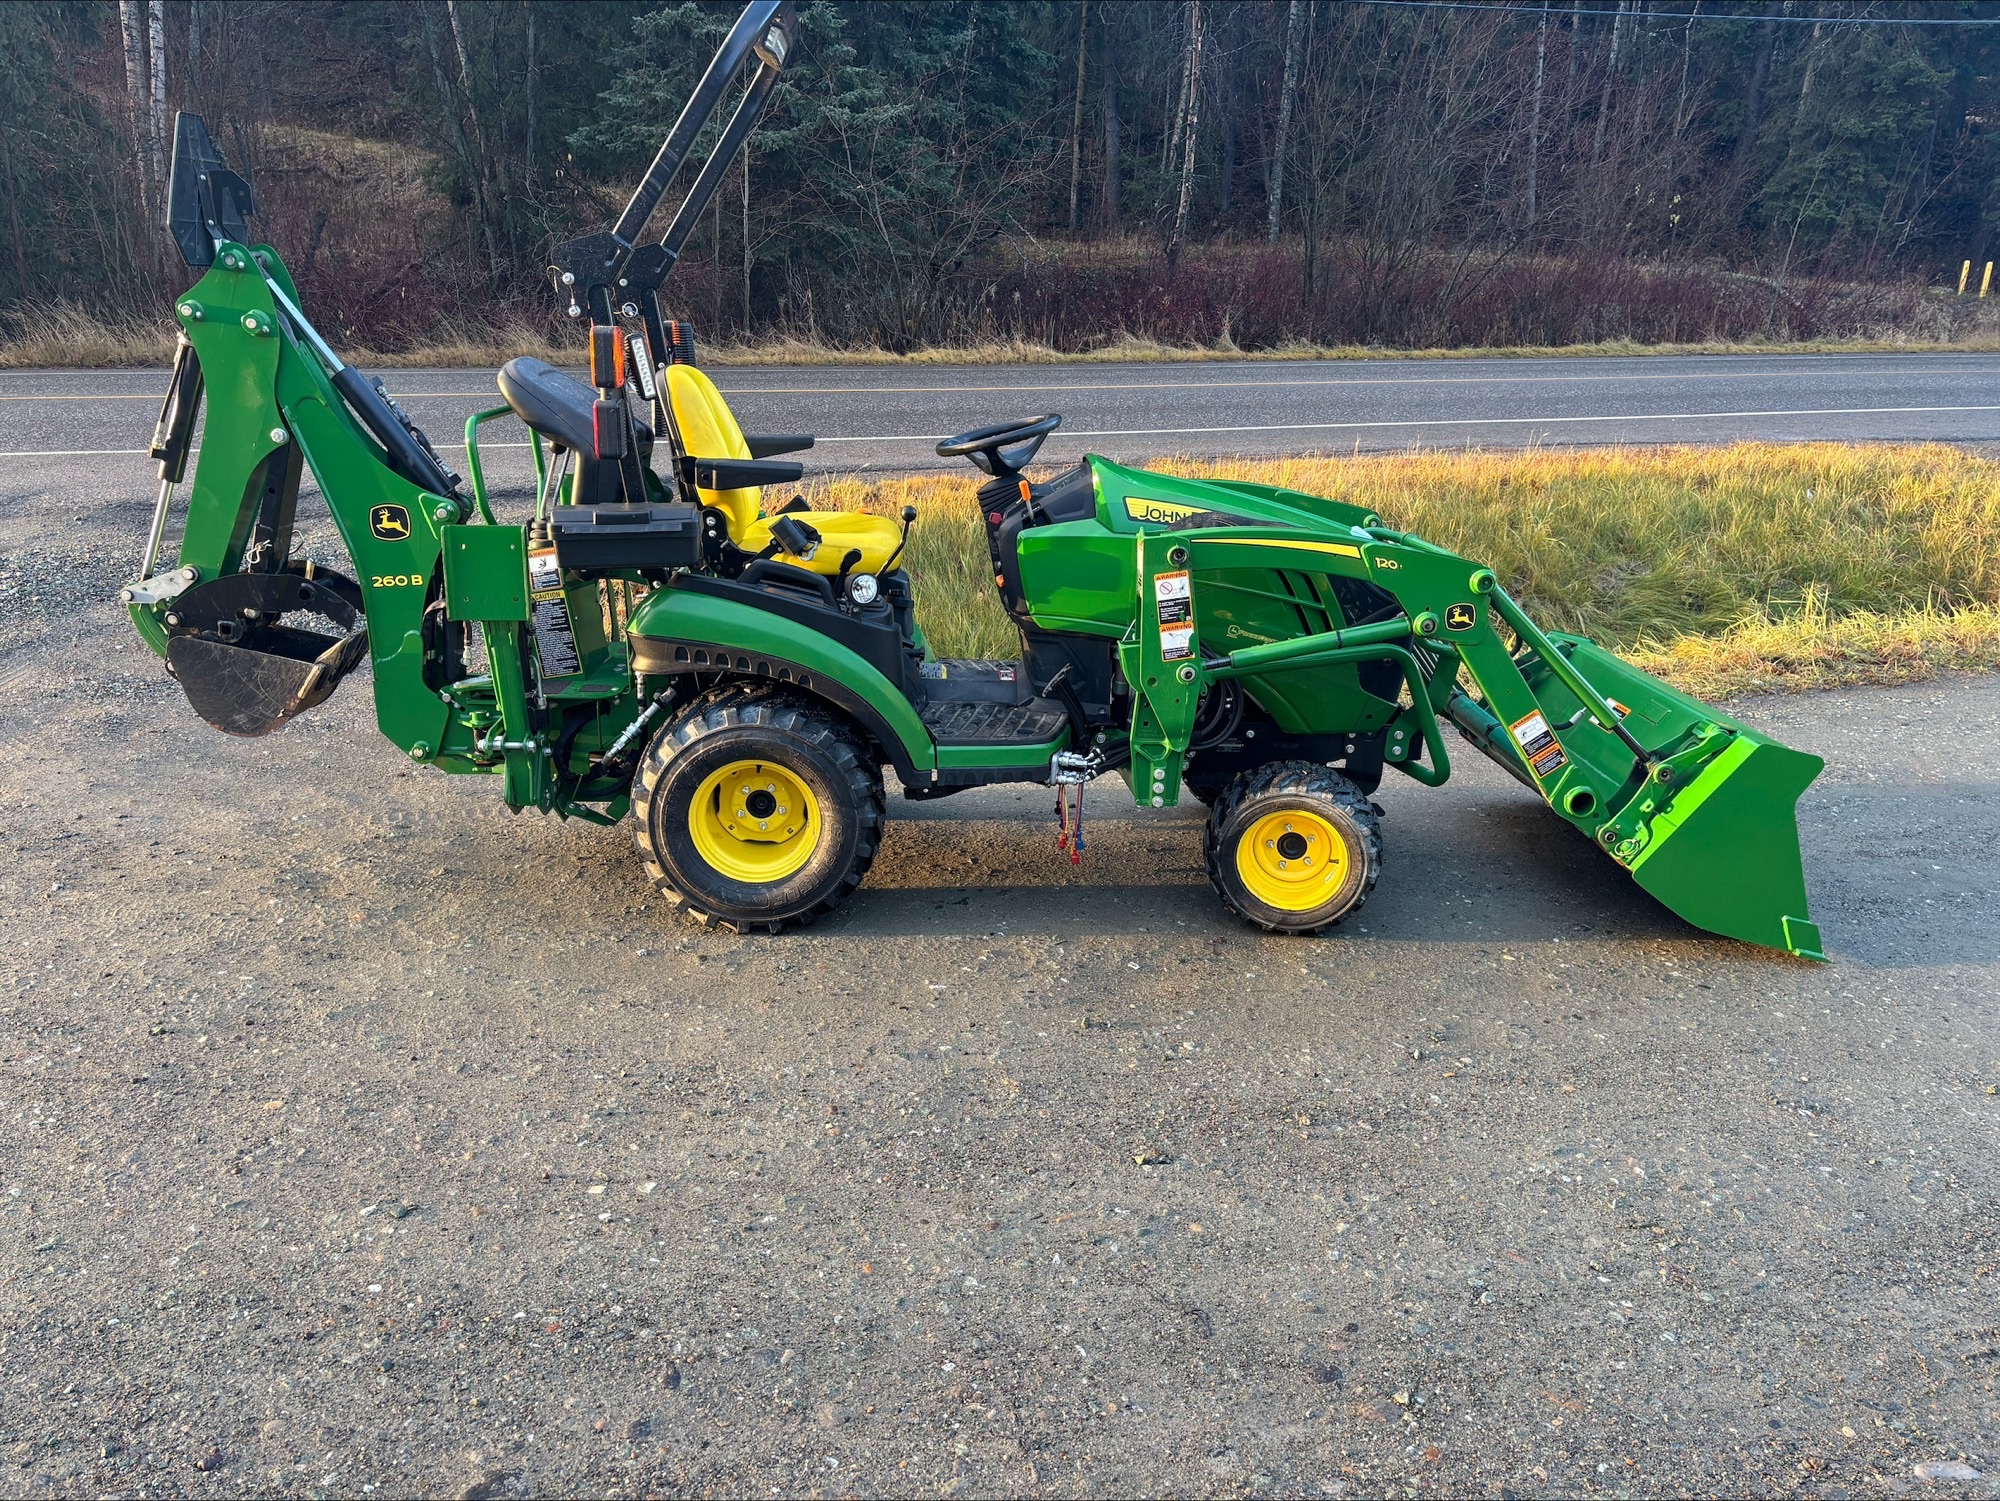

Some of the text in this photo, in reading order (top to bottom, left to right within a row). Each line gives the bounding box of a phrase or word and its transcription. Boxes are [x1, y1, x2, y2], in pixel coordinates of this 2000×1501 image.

[1139, 505, 1186, 522] JOHN
[1375, 557, 1398, 570] 120
[371, 574, 424, 588] 260 B
[1161, 571, 1187, 580] WARNING
[534, 591, 561, 600] CAUTION
[1166, 623, 1192, 631] WARNING
[773, 821, 844, 907] CARLISLE
